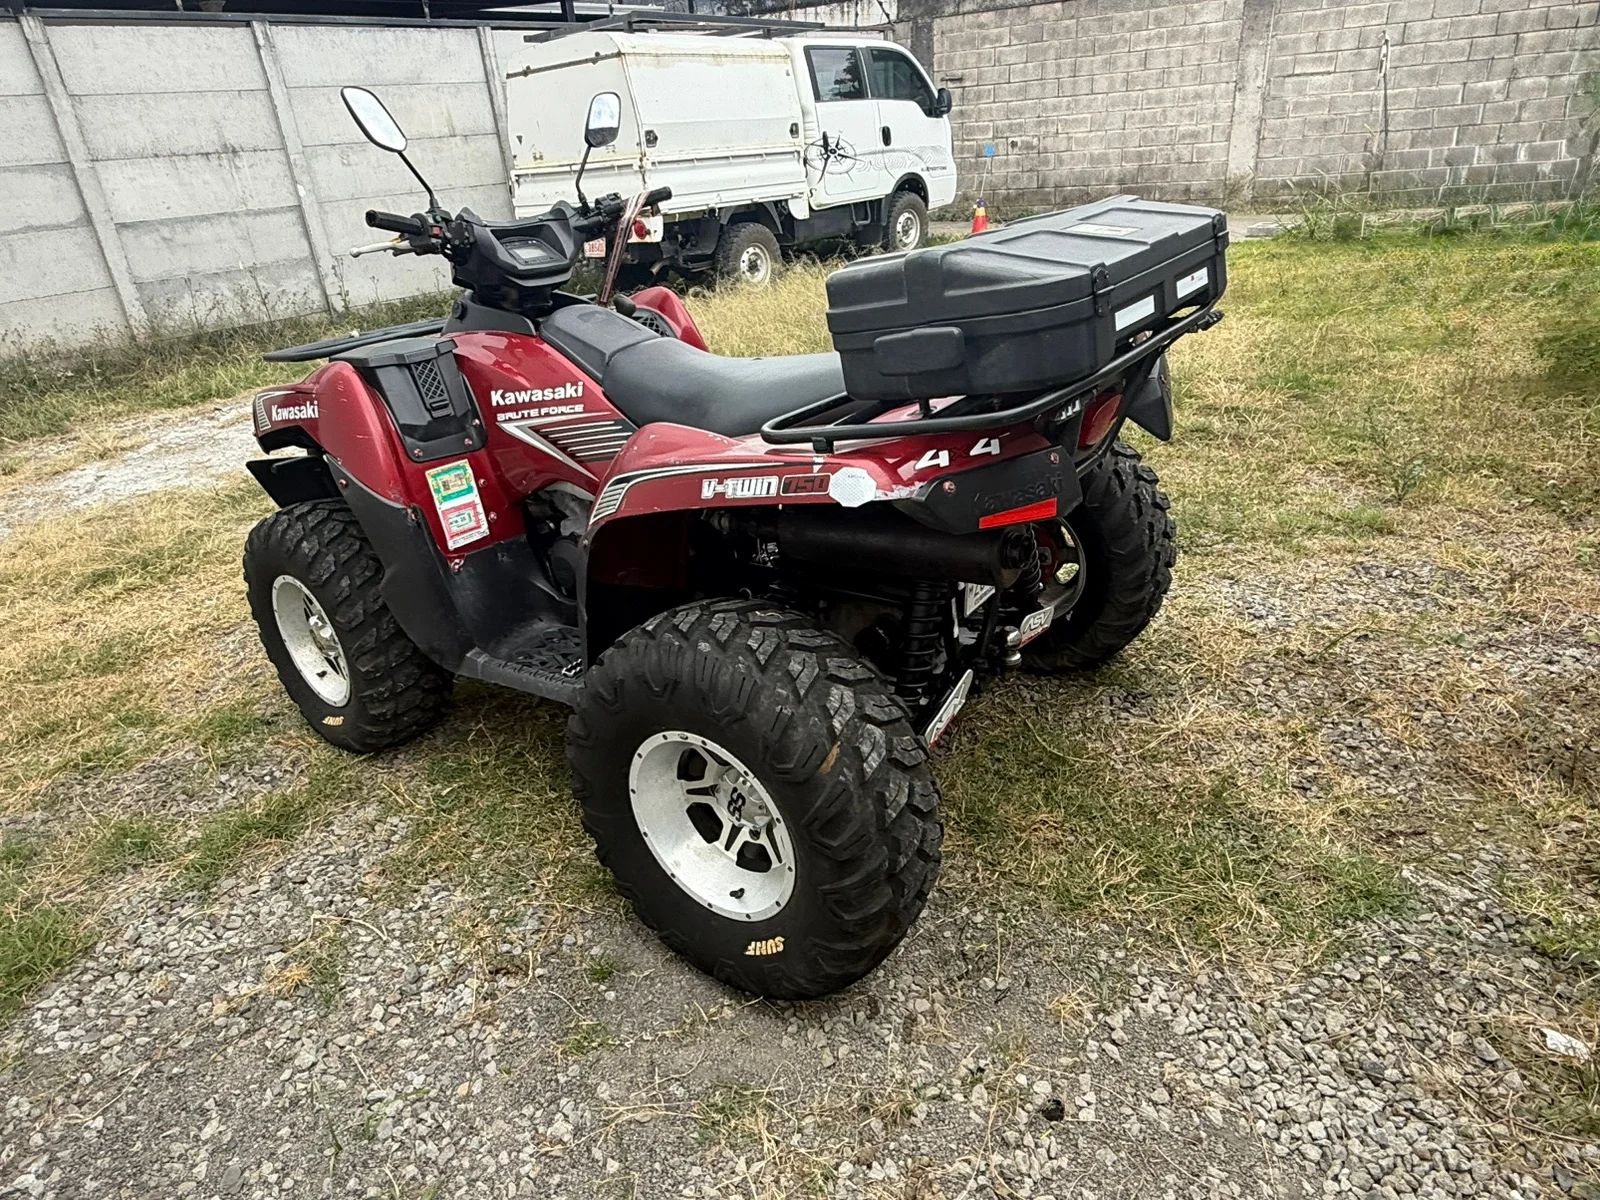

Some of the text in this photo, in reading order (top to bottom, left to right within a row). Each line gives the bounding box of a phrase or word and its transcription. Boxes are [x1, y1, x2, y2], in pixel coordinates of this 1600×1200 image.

[490, 381, 584, 406] Kawasaki
[271, 400, 319, 421] Kawasaki
[496, 404, 584, 422] BRUTE FORCE
[786, 475, 830, 493] 750
[743, 936, 785, 956] SUNF
